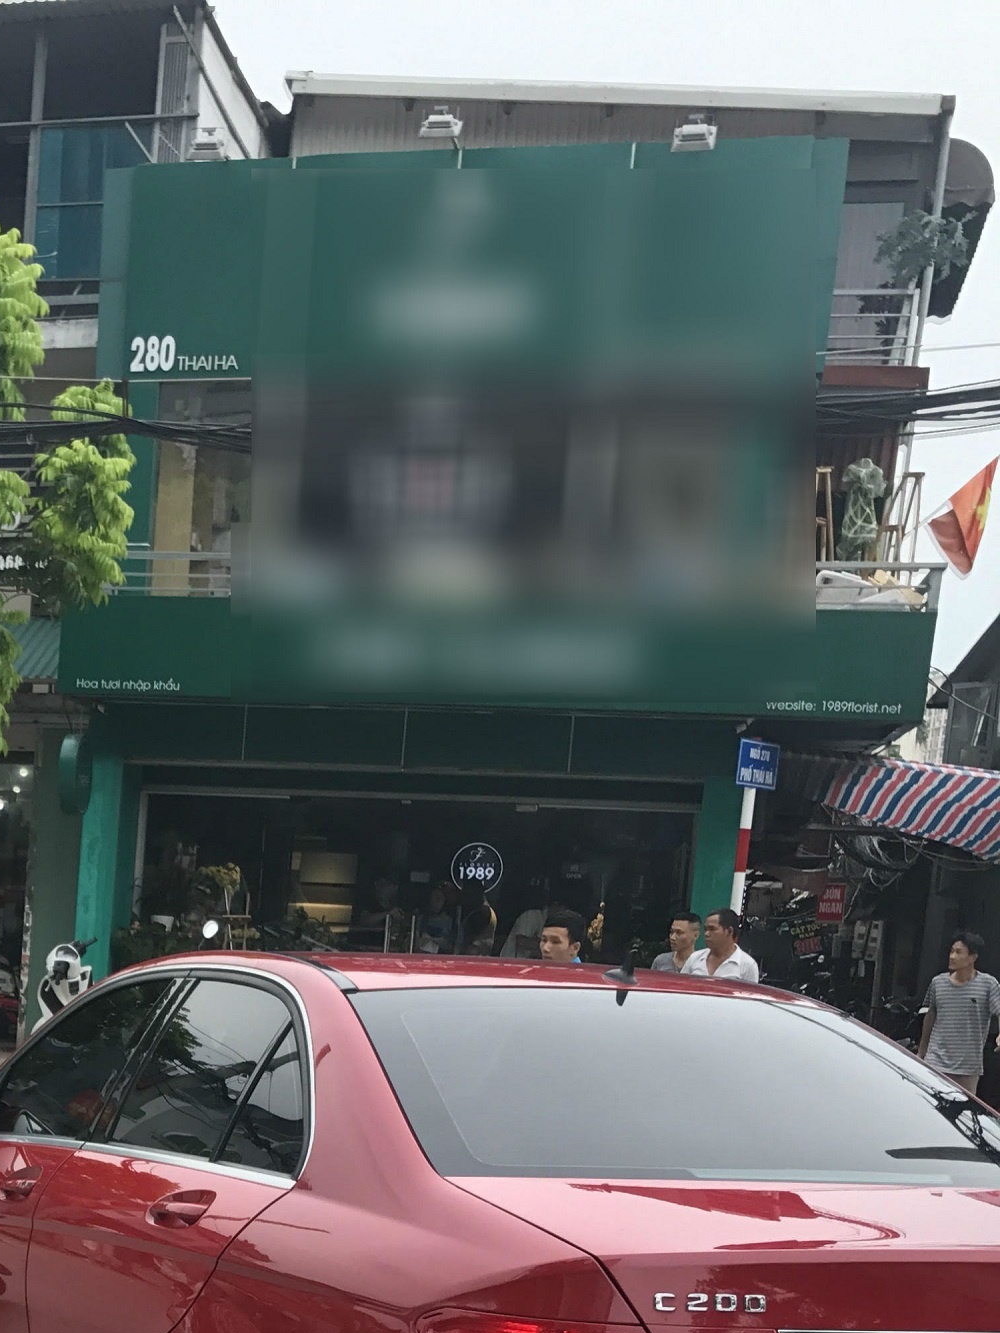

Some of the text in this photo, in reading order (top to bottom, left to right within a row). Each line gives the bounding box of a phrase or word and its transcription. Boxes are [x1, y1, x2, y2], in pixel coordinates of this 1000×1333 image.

[130, 335, 239, 372] 280 THAI HA
[76, 678, 98, 689] Hoa
[122, 679, 151, 692] nhập
[766, 700, 902, 714] website: 1989florist.net
[459, 866, 495, 880] 1989
[819, 902, 843, 914] NGAN
[654, 1292, 767, 1313] C 200
